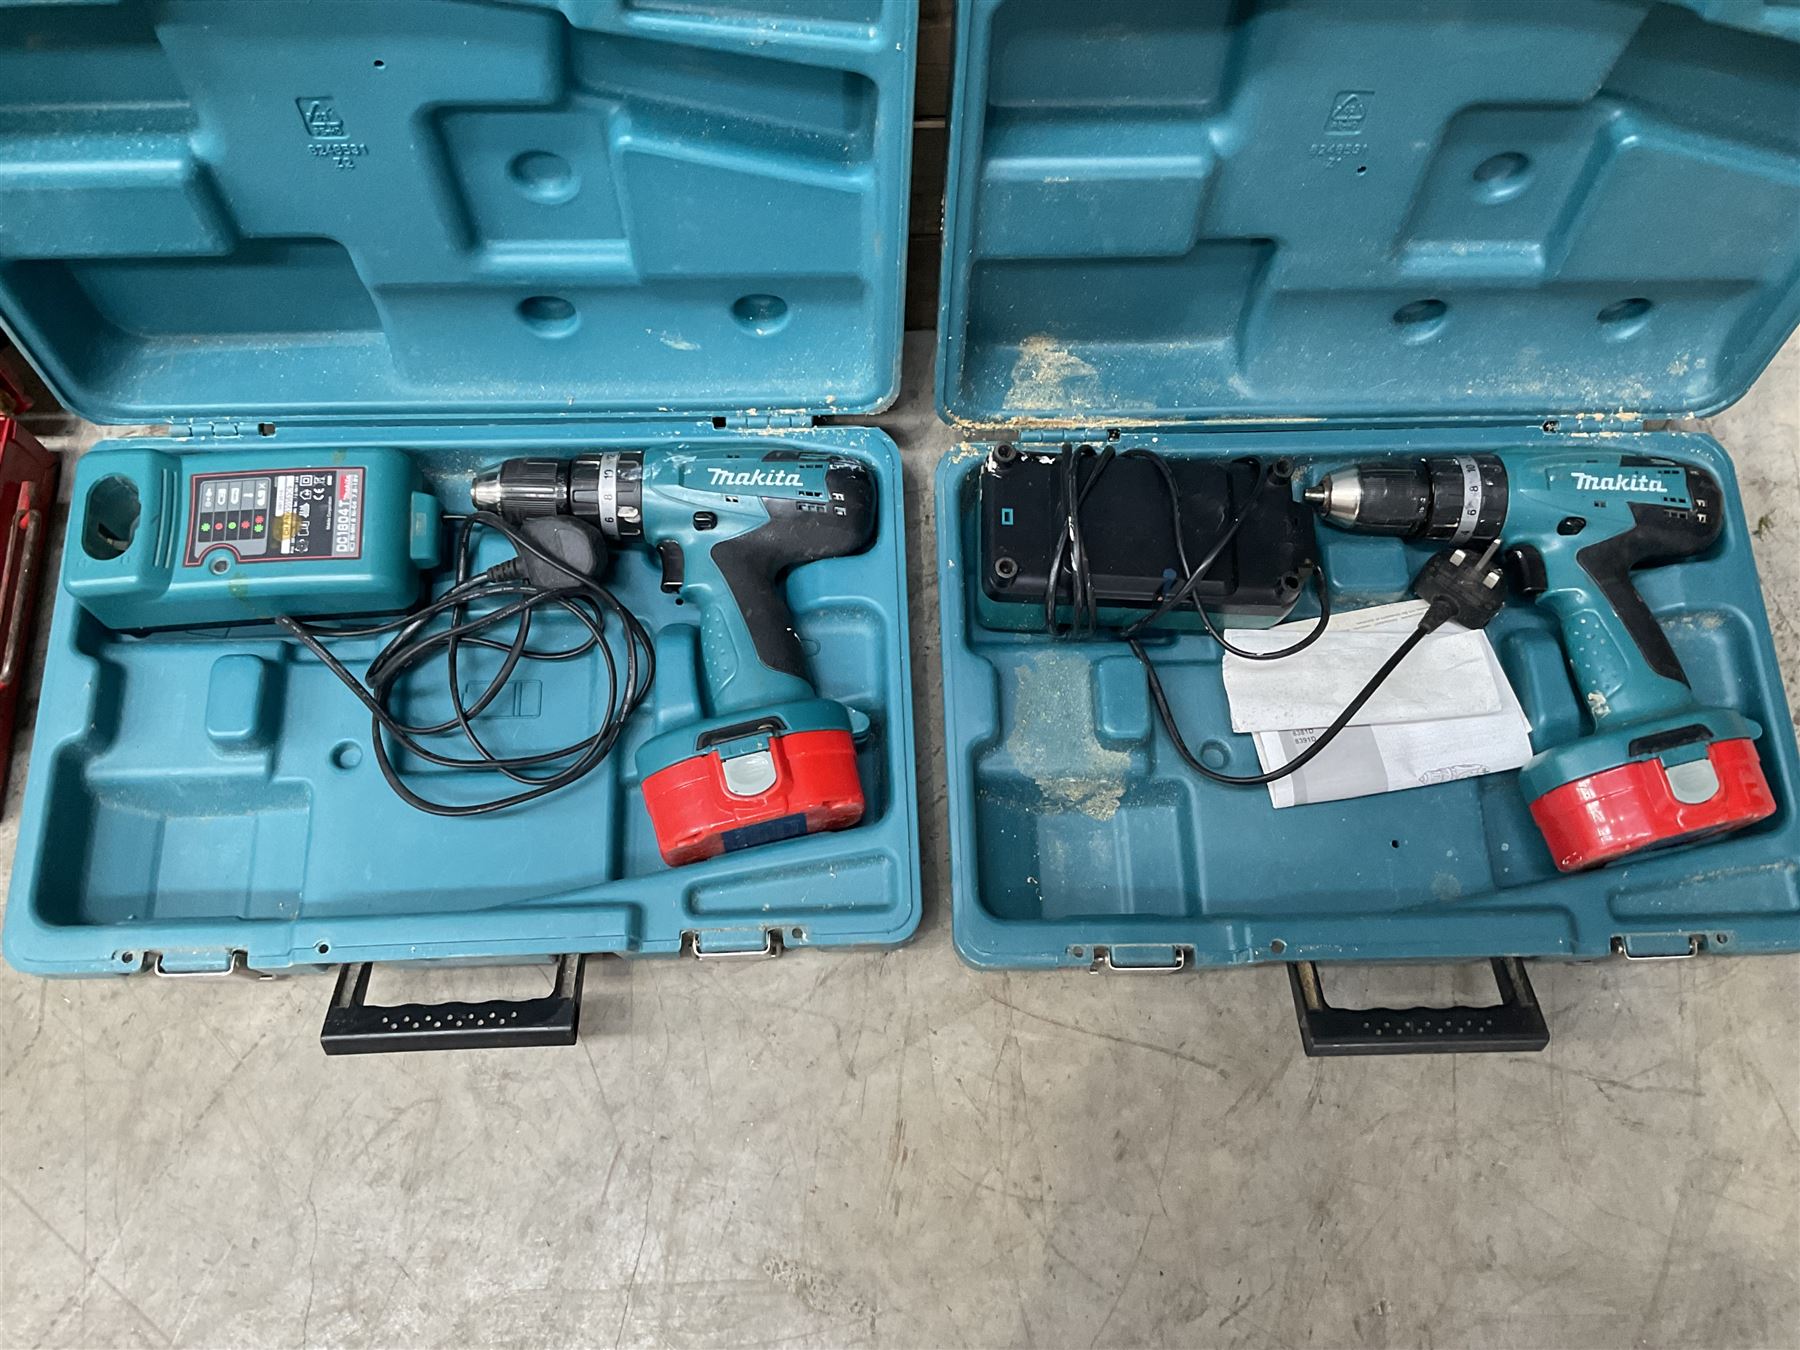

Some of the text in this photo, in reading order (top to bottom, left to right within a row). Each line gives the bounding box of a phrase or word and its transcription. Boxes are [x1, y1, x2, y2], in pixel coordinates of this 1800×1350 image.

[1465, 464, 1475, 473] 10
[603, 469, 613, 479] 10
[603, 493, 613, 502] 8
[604, 516, 614, 524] 6
[336, 499, 350, 553] DC1804T
